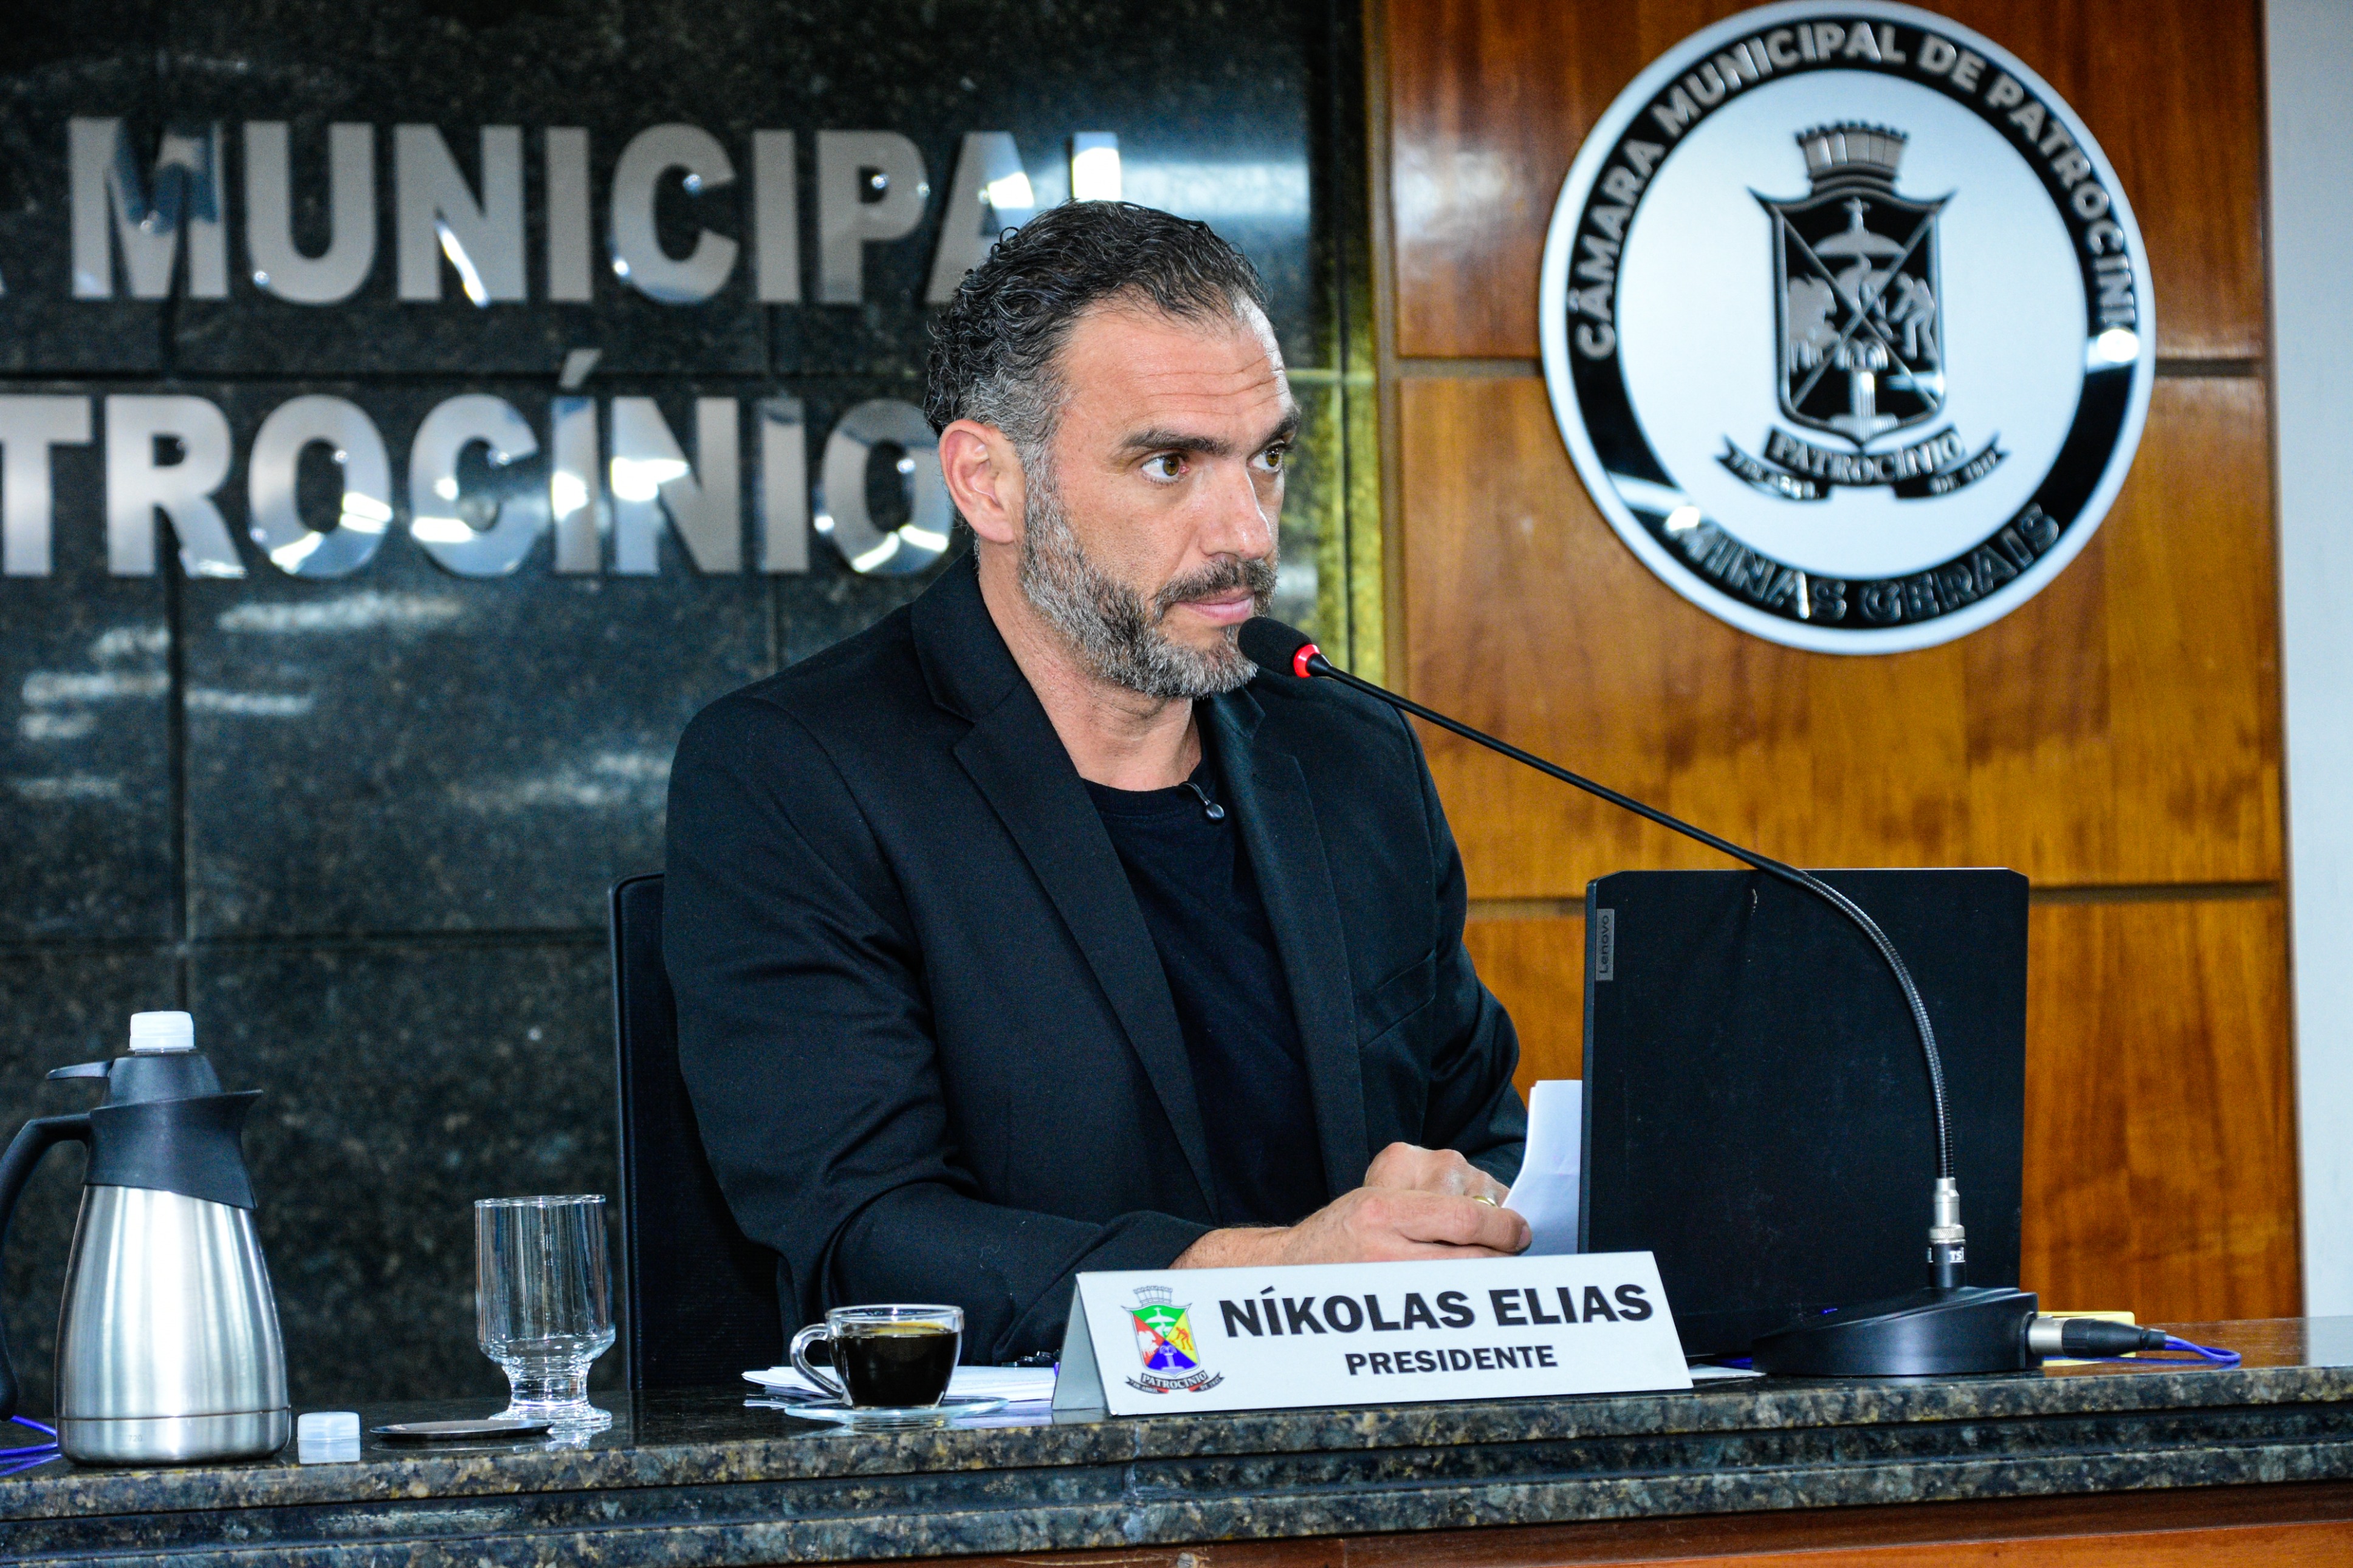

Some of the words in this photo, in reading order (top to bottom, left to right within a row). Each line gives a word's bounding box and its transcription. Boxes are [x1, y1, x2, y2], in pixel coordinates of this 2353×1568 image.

[1565, 139, 1667, 360] CÂMARA
[1649, 21, 1906, 140] MUNICIPAL
[1917, 33, 1987, 92] DE
[1984, 71, 2138, 363] PATROCINI
[1860, 502, 2059, 621] GERAIS
[1598, 915, 1609, 973] Lenovo
[1218, 1285, 1475, 1338] NÍKOLAS
[1488, 1284, 1654, 1326] ELIAS
[1345, 1345, 1559, 1375] PRESIDENTE
